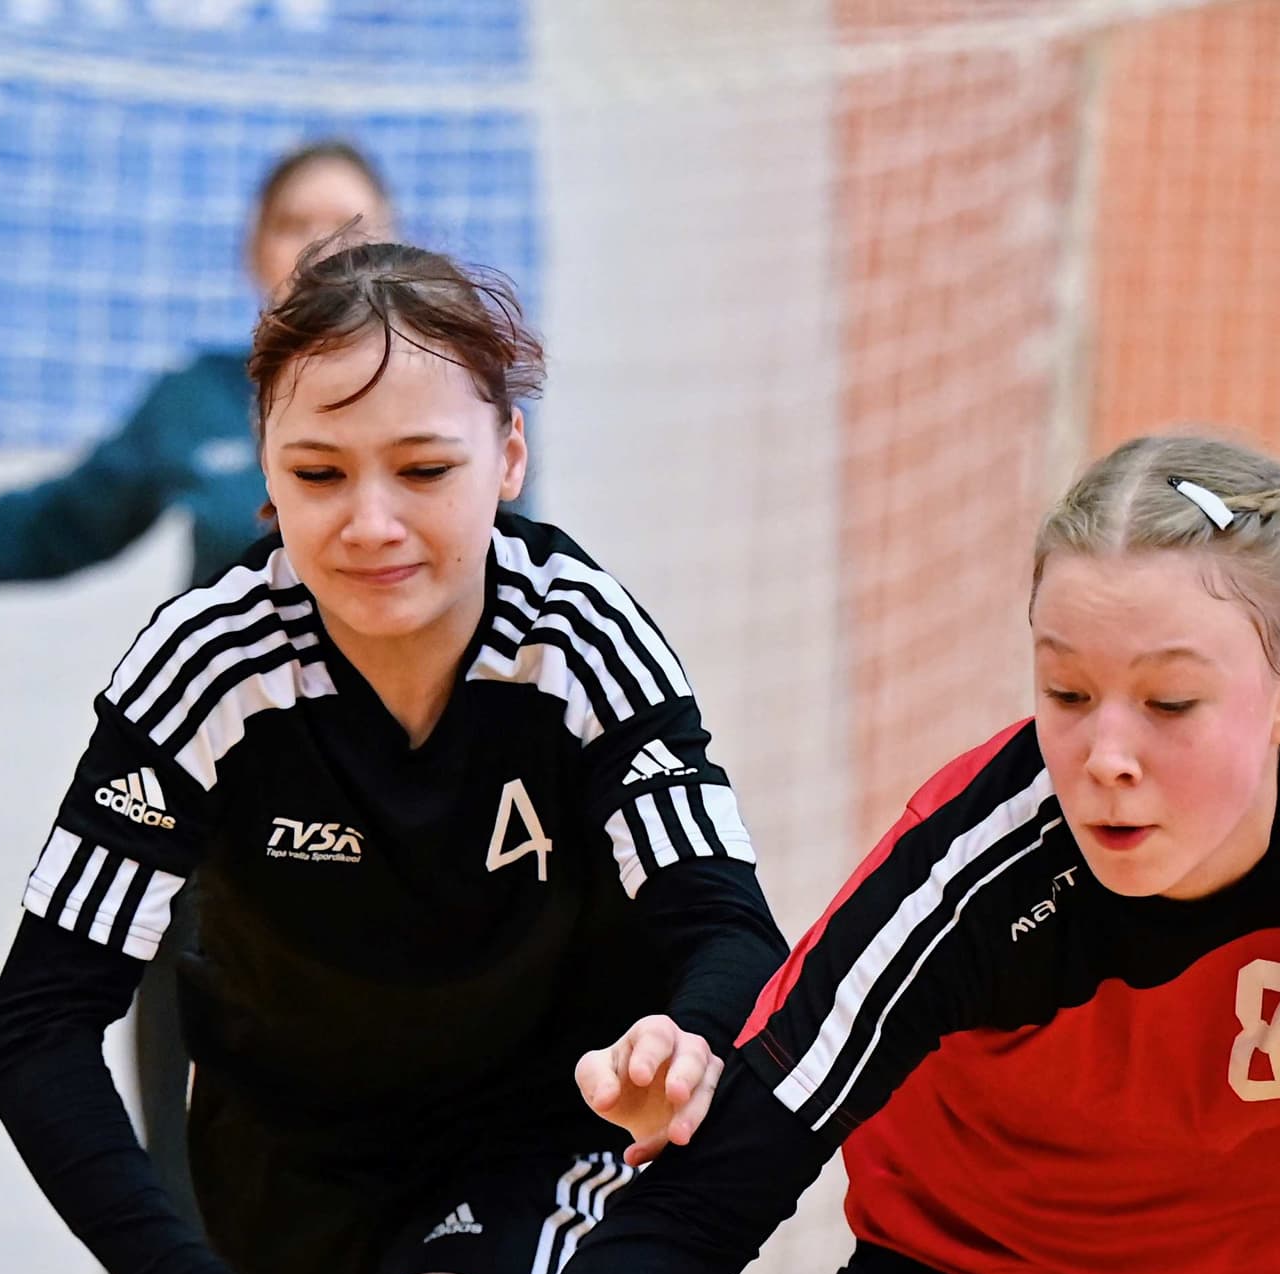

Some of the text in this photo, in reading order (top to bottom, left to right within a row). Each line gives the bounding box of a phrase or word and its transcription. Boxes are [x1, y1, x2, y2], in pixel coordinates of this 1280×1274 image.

[95, 787, 176, 830] adidas
[485, 778, 553, 882] 4
[267, 816, 364, 854] TVSK
